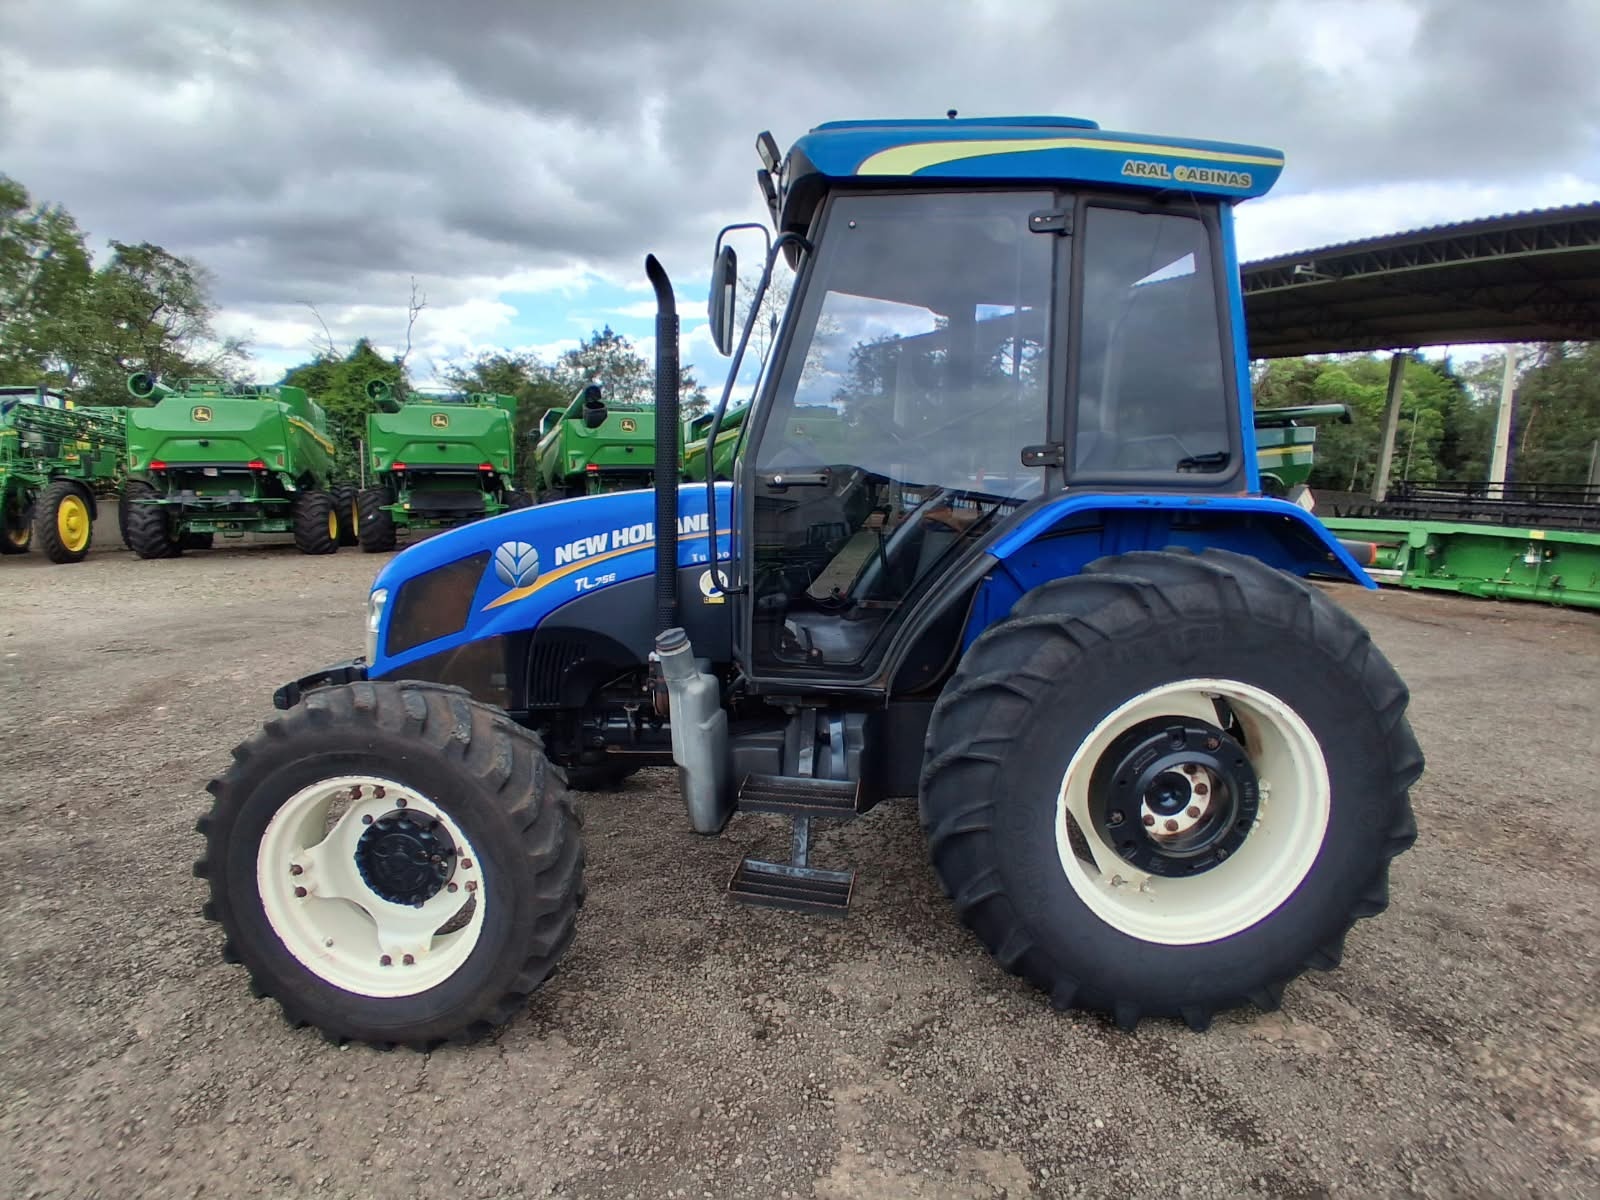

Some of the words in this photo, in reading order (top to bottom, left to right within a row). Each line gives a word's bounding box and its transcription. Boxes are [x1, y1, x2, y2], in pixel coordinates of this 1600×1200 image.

[1122, 160, 1170, 178] ARAL
[555, 532, 609, 566] NEW
[612, 513, 710, 549] HOLND
